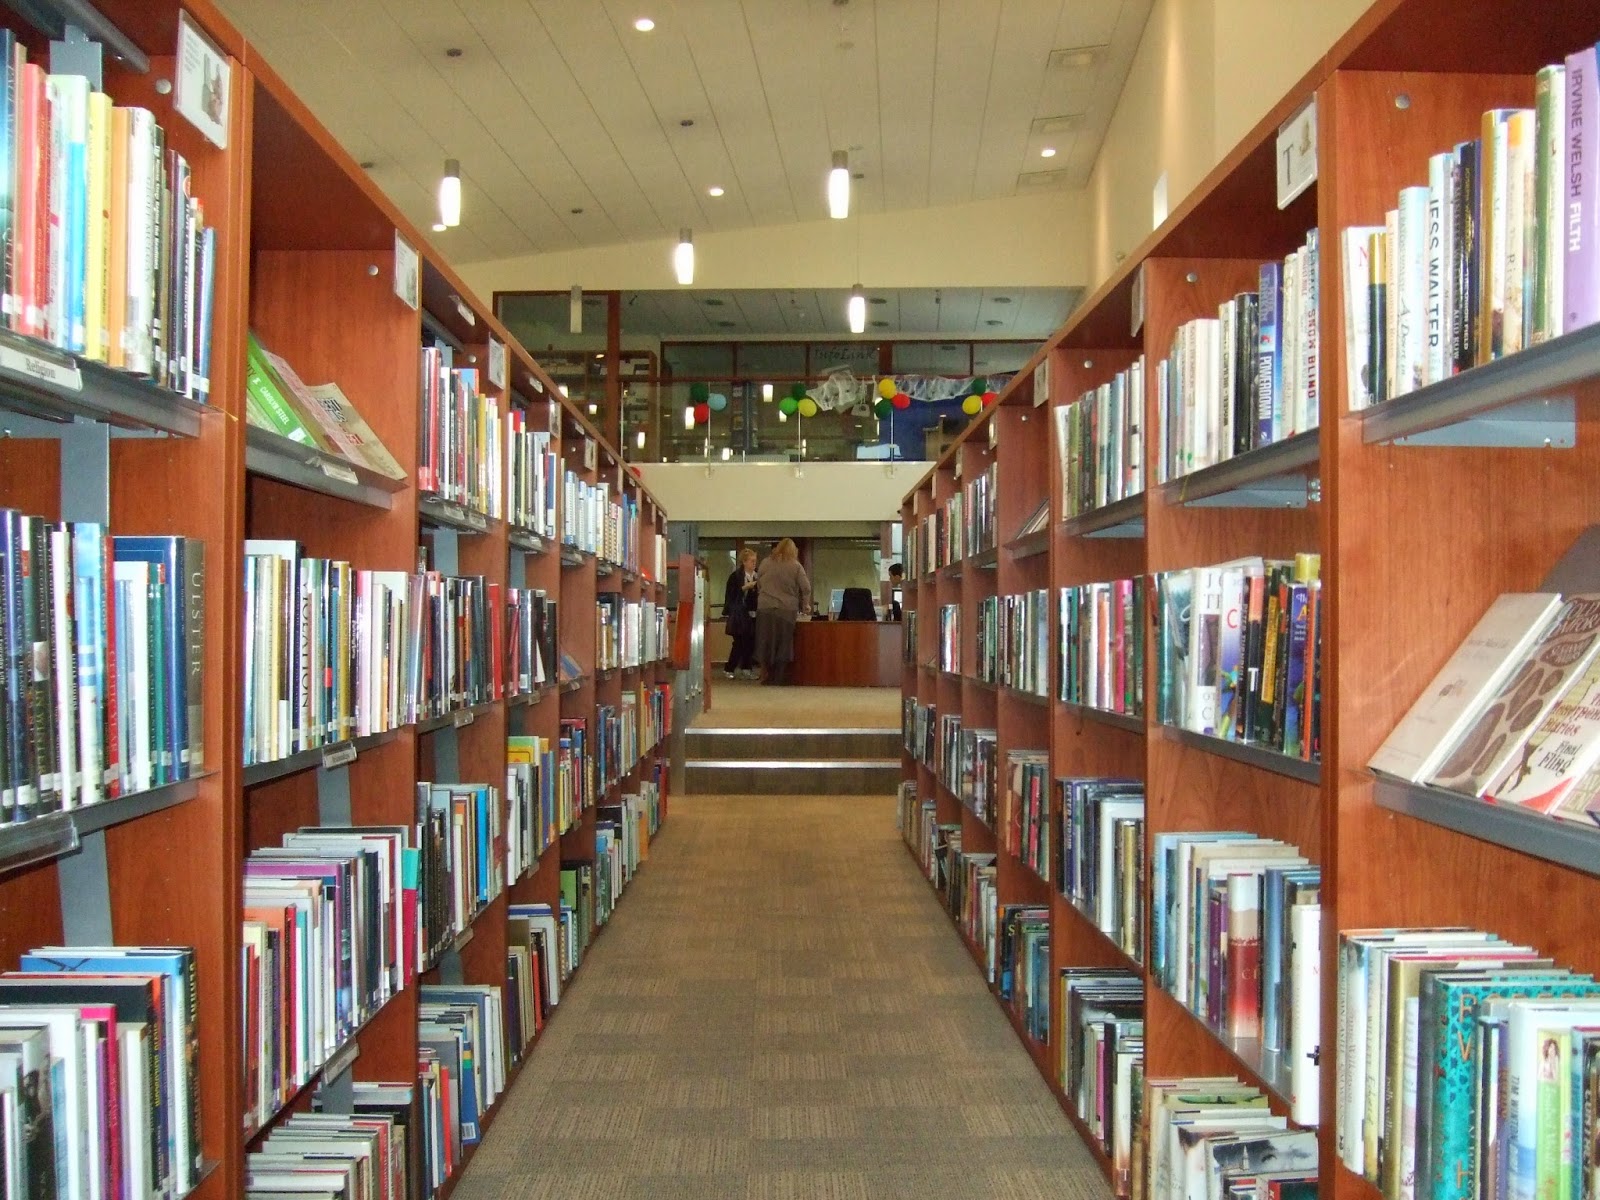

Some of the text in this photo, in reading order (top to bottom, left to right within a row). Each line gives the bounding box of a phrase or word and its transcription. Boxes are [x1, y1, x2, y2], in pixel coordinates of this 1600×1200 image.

[1568, 67, 1584, 252] IRVINE WELSH FILTH
[1429, 199, 1440, 348] JESS WALTER
[25, 357, 56, 379] Religion
[1307, 308, 1317, 399] SNOW BLIND
[260, 386, 290, 425] CAROLYN STEEL
[1259, 355, 1274, 420] POWERDOWN
[191, 571, 202, 676] ULSTER
[1537, 752, 1575, 777] Fling
[1509, 1075, 1520, 1140] TIM WINTON
